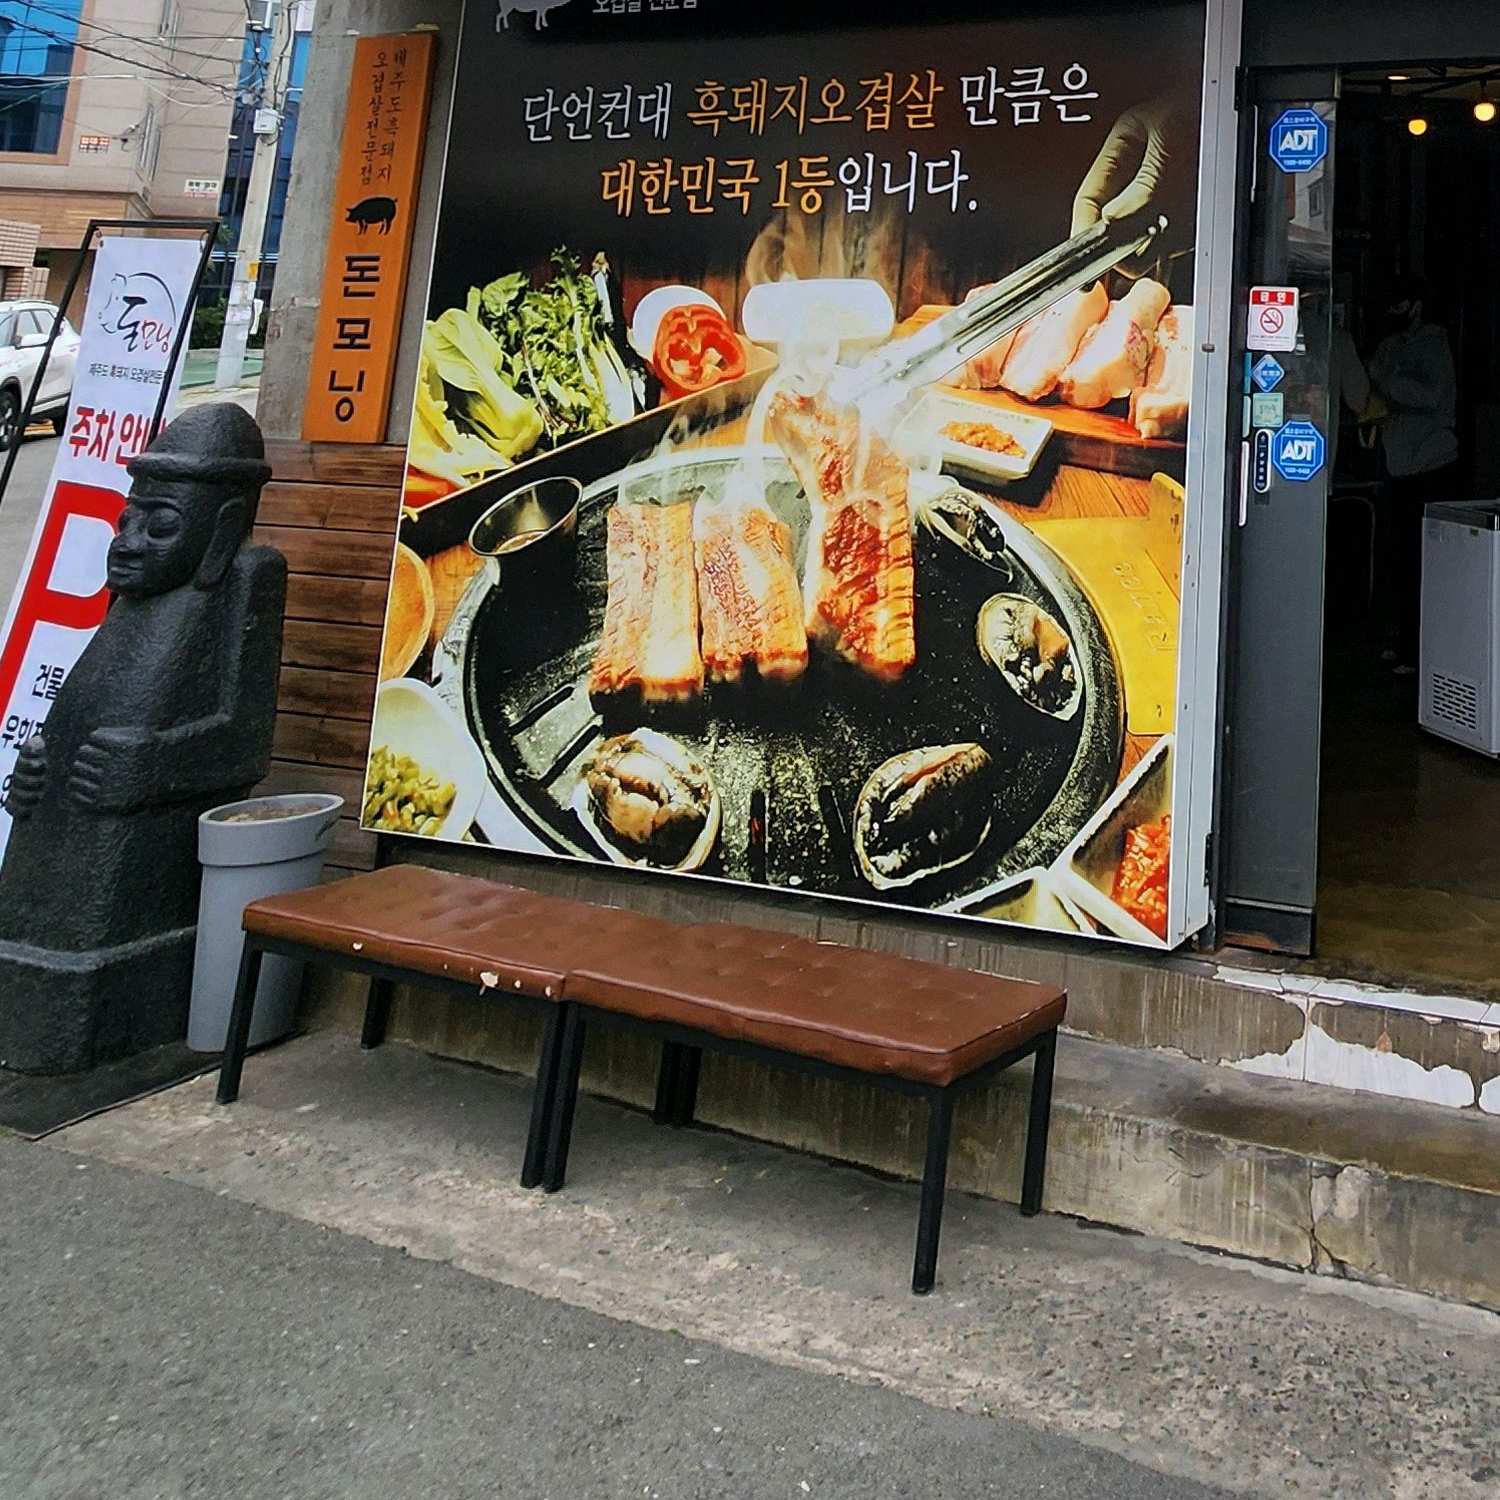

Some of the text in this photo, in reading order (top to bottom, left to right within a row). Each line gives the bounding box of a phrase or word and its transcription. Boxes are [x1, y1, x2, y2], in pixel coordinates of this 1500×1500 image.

[522, 61, 1099, 143] 단언컨대 흑돼지오겹살 만큼은
[1280, 130, 1318, 151] ADT
[599, 150, 978, 217] 대한민국 1등입니다.
[328, 255, 381, 422] 돈모닝
[130, 366, 167, 386] 오겹살전문
[68, 406, 168, 466] 주차 안
[1281, 441, 1316, 462] ADT
[0, 481, 128, 726] P
